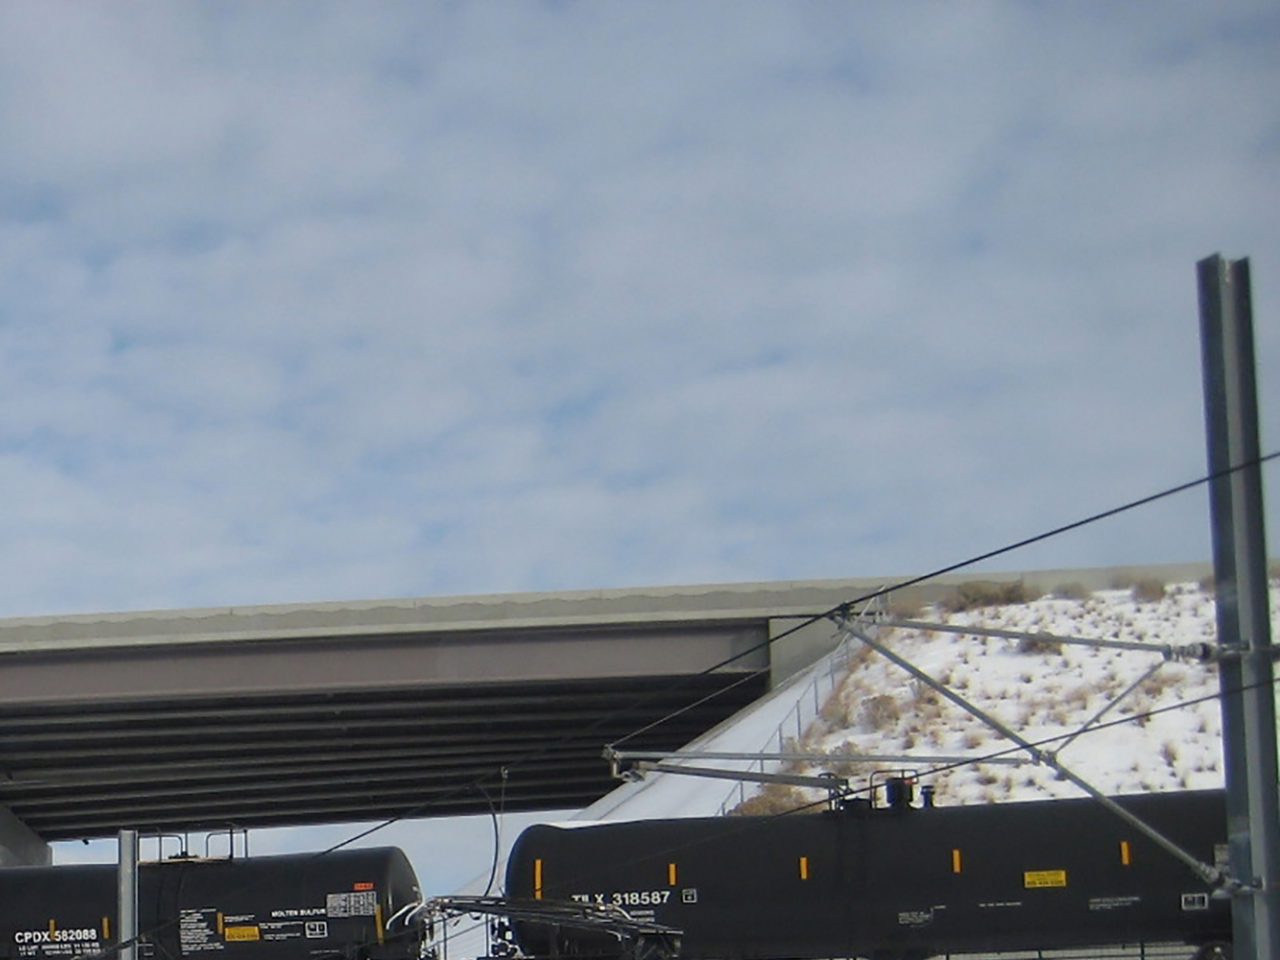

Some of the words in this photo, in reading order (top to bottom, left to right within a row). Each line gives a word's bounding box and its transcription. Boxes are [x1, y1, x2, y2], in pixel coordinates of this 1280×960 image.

[612, 890, 671, 906] 318587
[14, 931, 51, 944] CPDX
[54, 928, 97, 942] 582088
